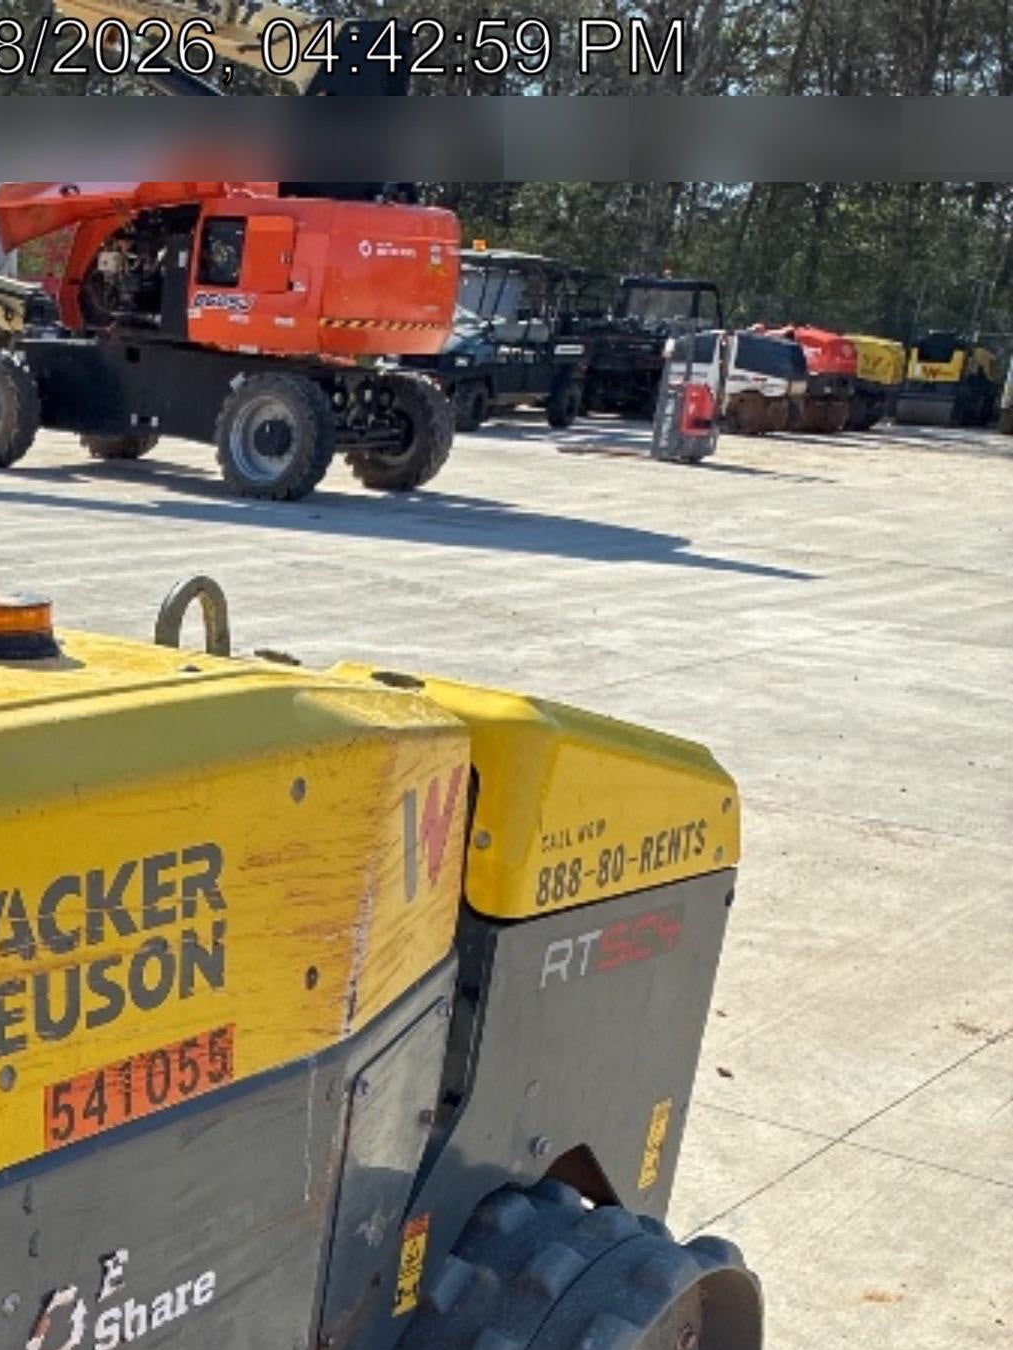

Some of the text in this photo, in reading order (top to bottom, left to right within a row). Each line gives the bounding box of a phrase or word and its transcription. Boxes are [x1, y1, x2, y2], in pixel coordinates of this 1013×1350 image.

[535, 818, 708, 907] 888-80-RENTS
[541, 818, 607, 853] CALL NOW
[50, 1027, 229, 1141] 541055
